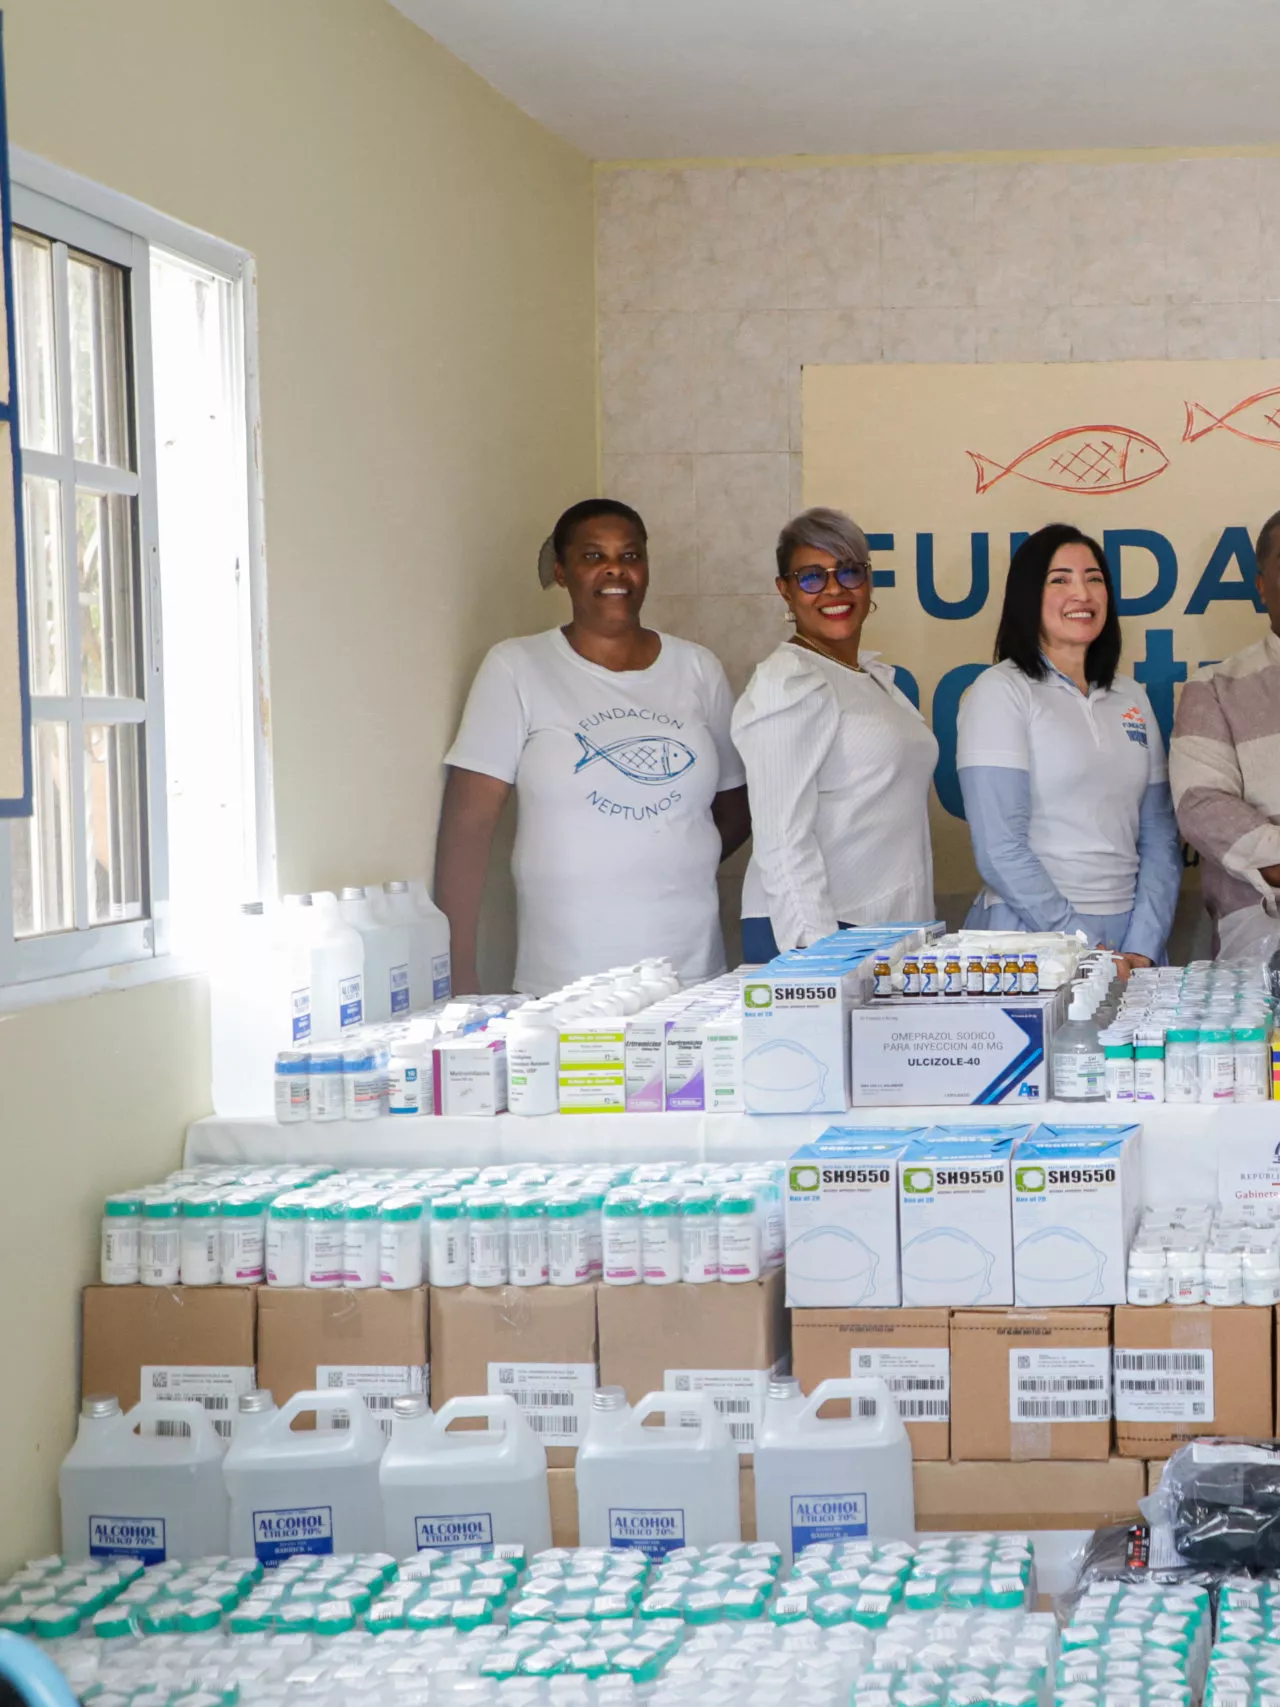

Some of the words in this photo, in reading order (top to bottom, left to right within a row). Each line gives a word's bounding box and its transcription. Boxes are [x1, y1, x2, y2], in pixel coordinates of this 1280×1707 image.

[586, 789, 682, 821] NEPTUNOS
[774, 986, 837, 1000] SH9550
[891, 1031, 953, 1042] OMEPRAZOL
[882, 1042, 911, 1051] PARA
[913, 1042, 969, 1052] INYECCION
[971, 1041, 984, 1050] 40
[986, 1041, 1004, 1050] MG
[907, 1057, 981, 1067] ULCIZOLE-40
[822, 1169, 890, 1183] SH9550
[936, 1169, 1004, 1185] SH9550
[1048, 1168, 1116, 1184] SH9550
[1235, 1189, 1279, 1199] Gabinete
[797, 1501, 862, 1516] ALCOHOL
[258, 1515, 325, 1532] ALCOHOL
[420, 1521, 486, 1536] ALCOHOL
[614, 1516, 679, 1529] ALCOHOL
[94, 1524, 159, 1539] ALCOHOL
